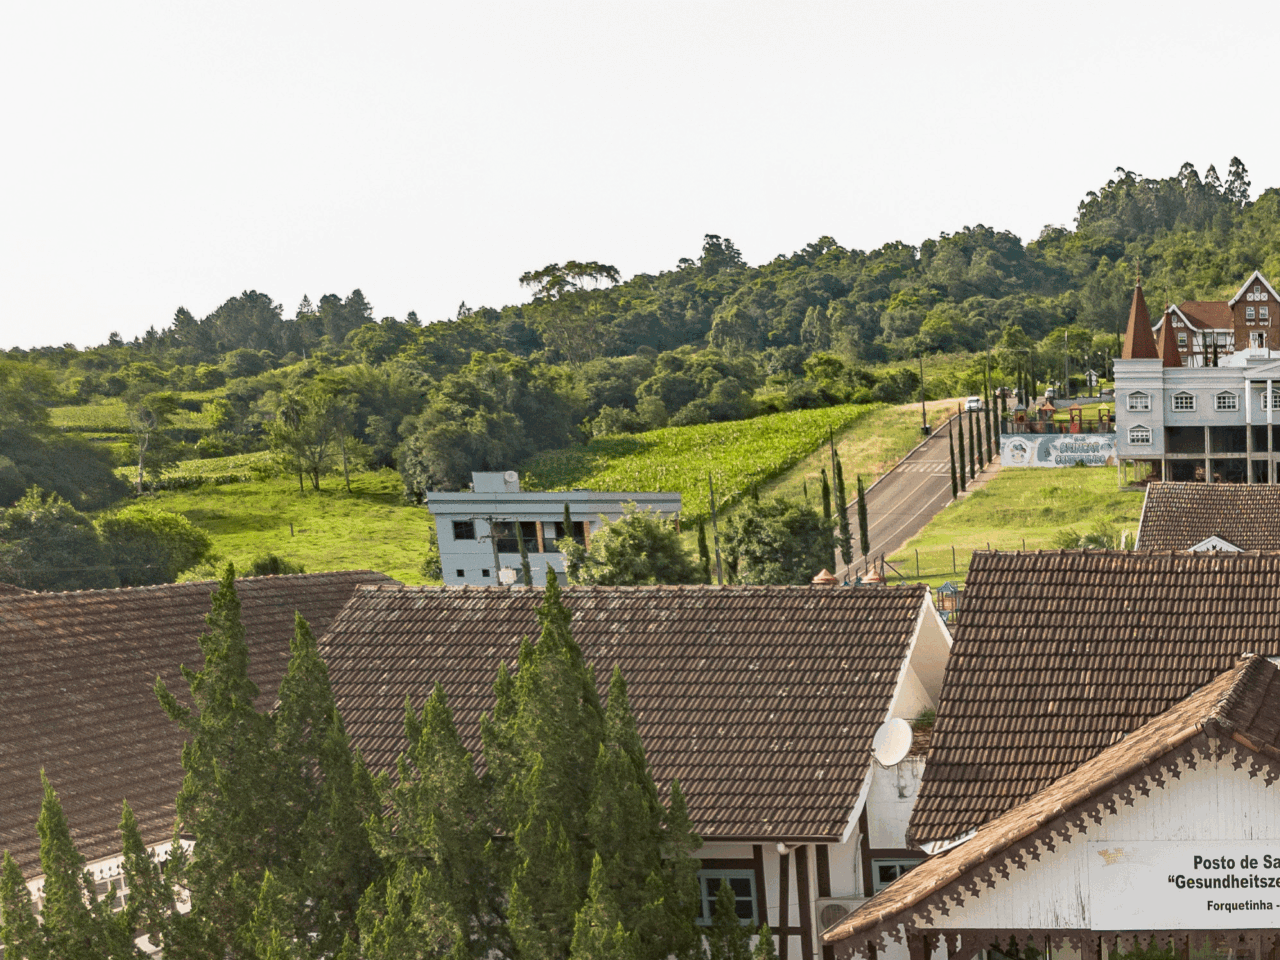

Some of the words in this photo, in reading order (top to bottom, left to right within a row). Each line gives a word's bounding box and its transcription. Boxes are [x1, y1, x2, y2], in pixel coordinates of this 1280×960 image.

[1193, 855, 1236, 870] Posto
[1240, 854, 1259, 869] de
[1207, 899, 1273, 913] Forquetinha
